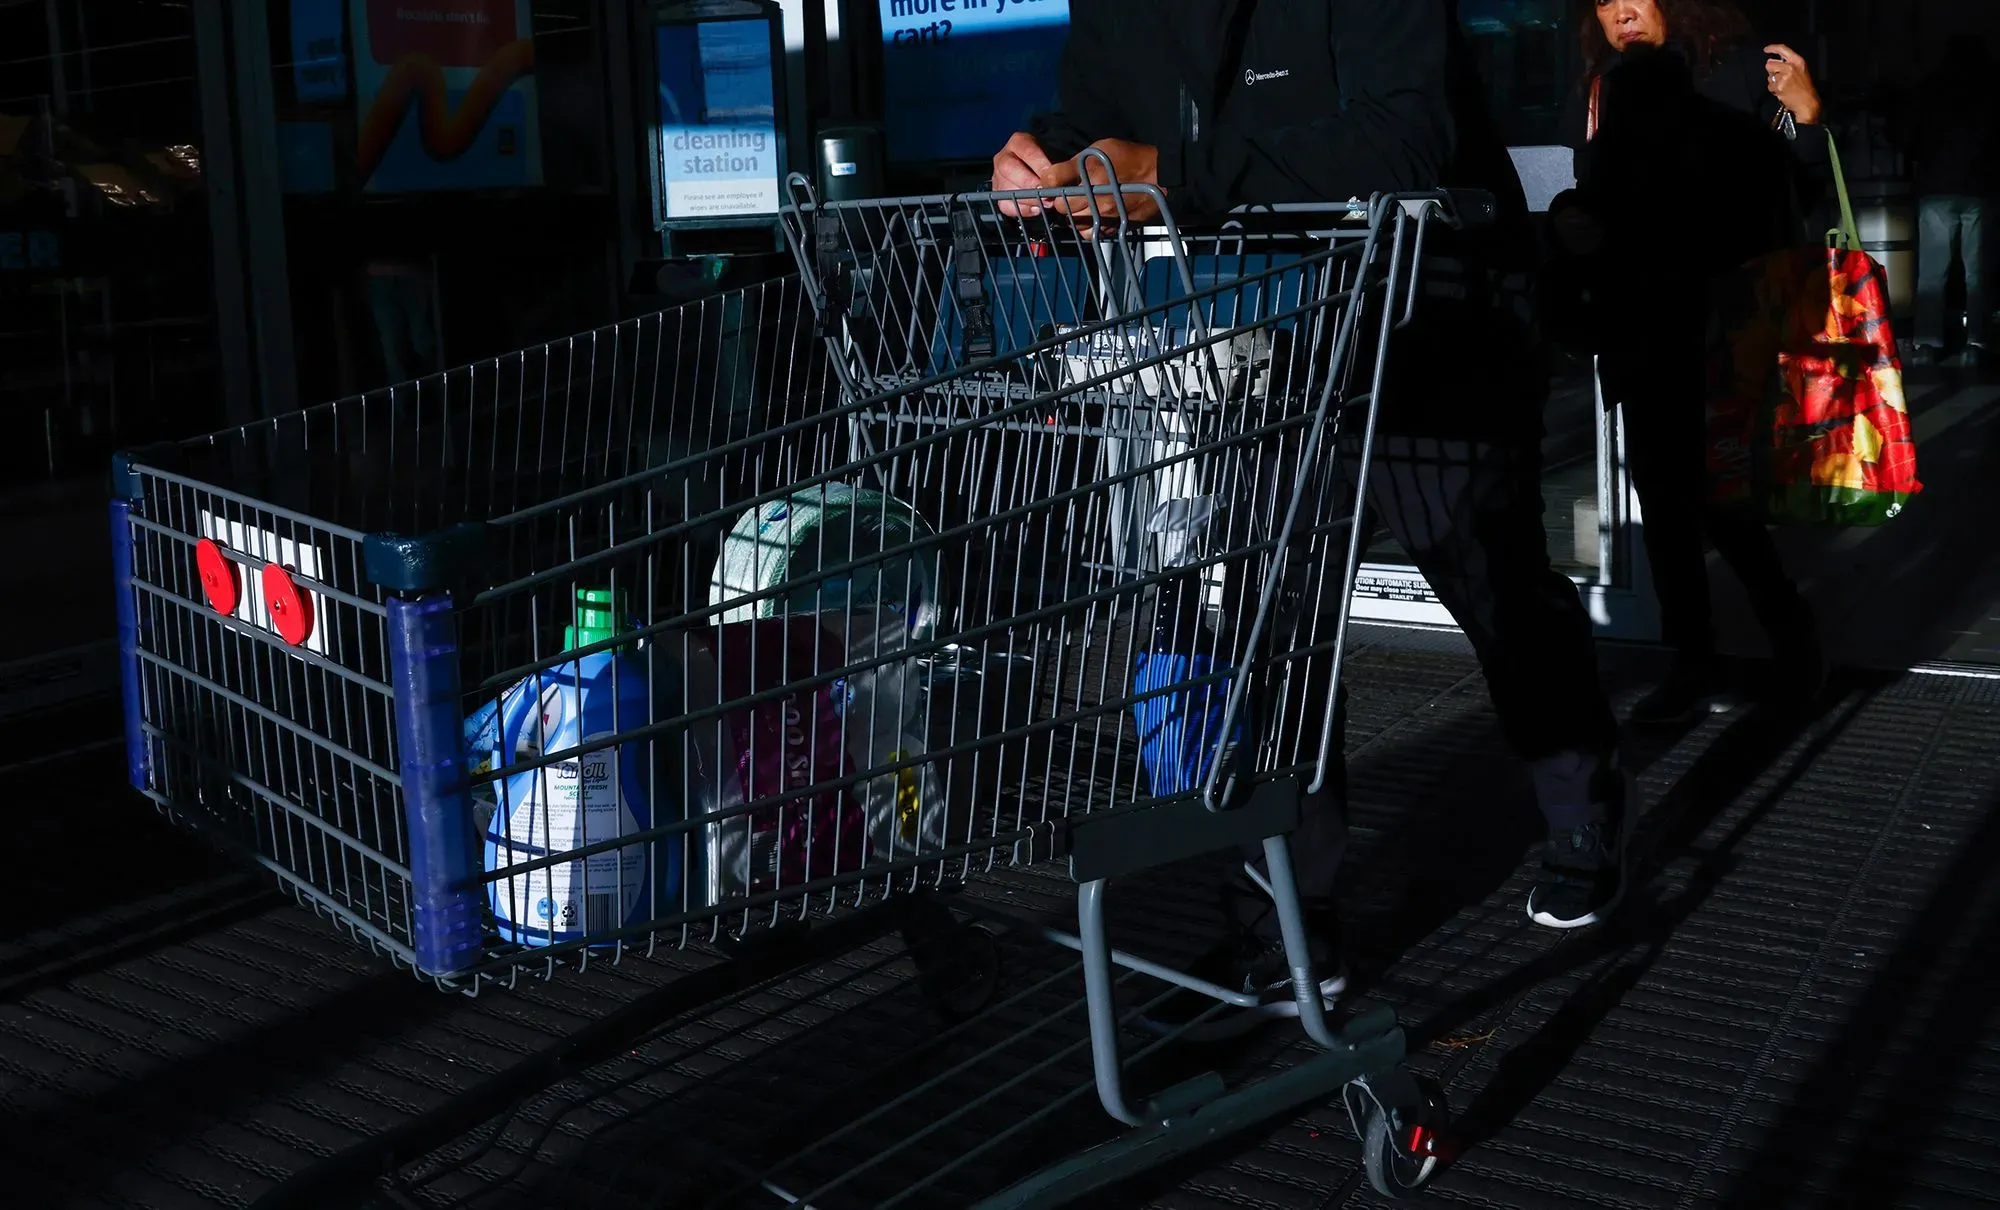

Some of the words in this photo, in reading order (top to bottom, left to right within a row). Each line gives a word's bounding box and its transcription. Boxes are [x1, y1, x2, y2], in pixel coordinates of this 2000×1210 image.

[893, 20, 953, 47] cart?
[673, 127, 766, 152] cleaning
[683, 152, 758, 174] station
[726, 192, 758, 200] employee
[721, 202, 760, 210] unavailable.
[1355, 577, 1376, 585] UTION:
[1376, 579, 1412, 588] AUTOMATIC
